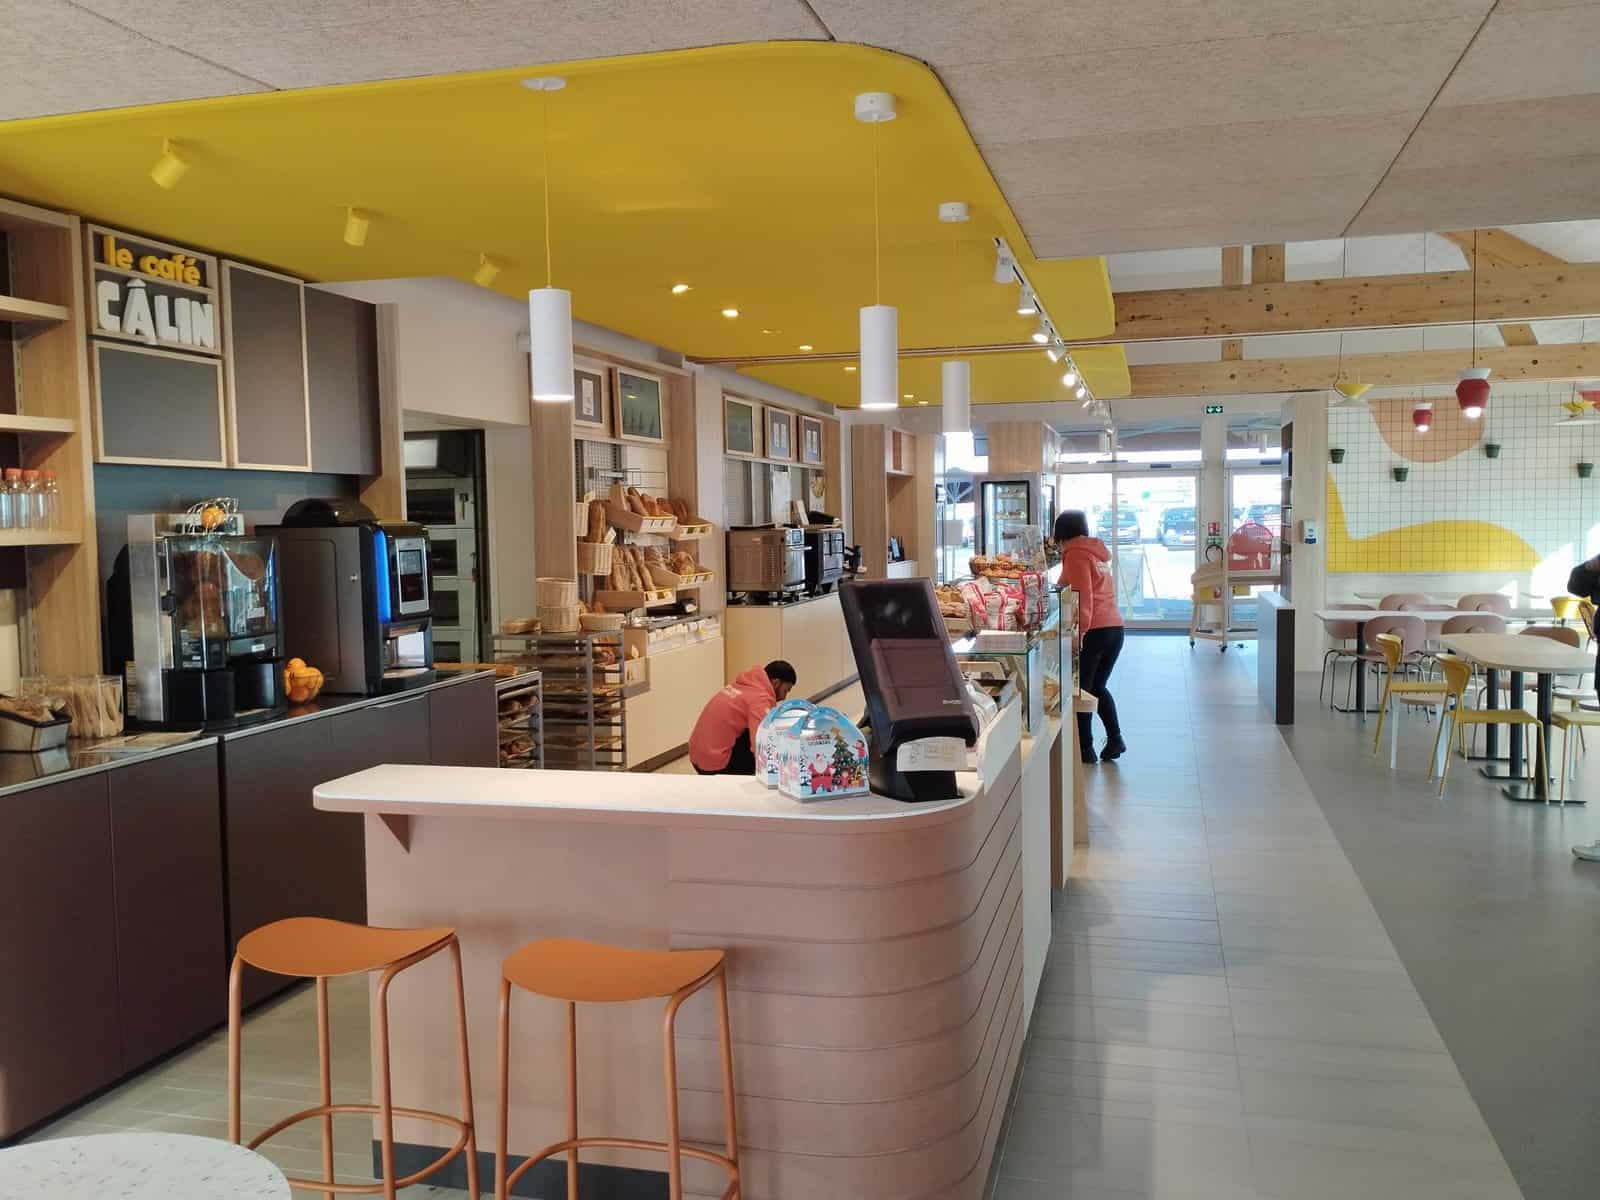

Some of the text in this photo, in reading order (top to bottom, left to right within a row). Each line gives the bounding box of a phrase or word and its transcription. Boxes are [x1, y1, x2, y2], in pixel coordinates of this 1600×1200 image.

[104, 235, 200, 286] le café
[97, 278, 214, 349] CÂLIN
